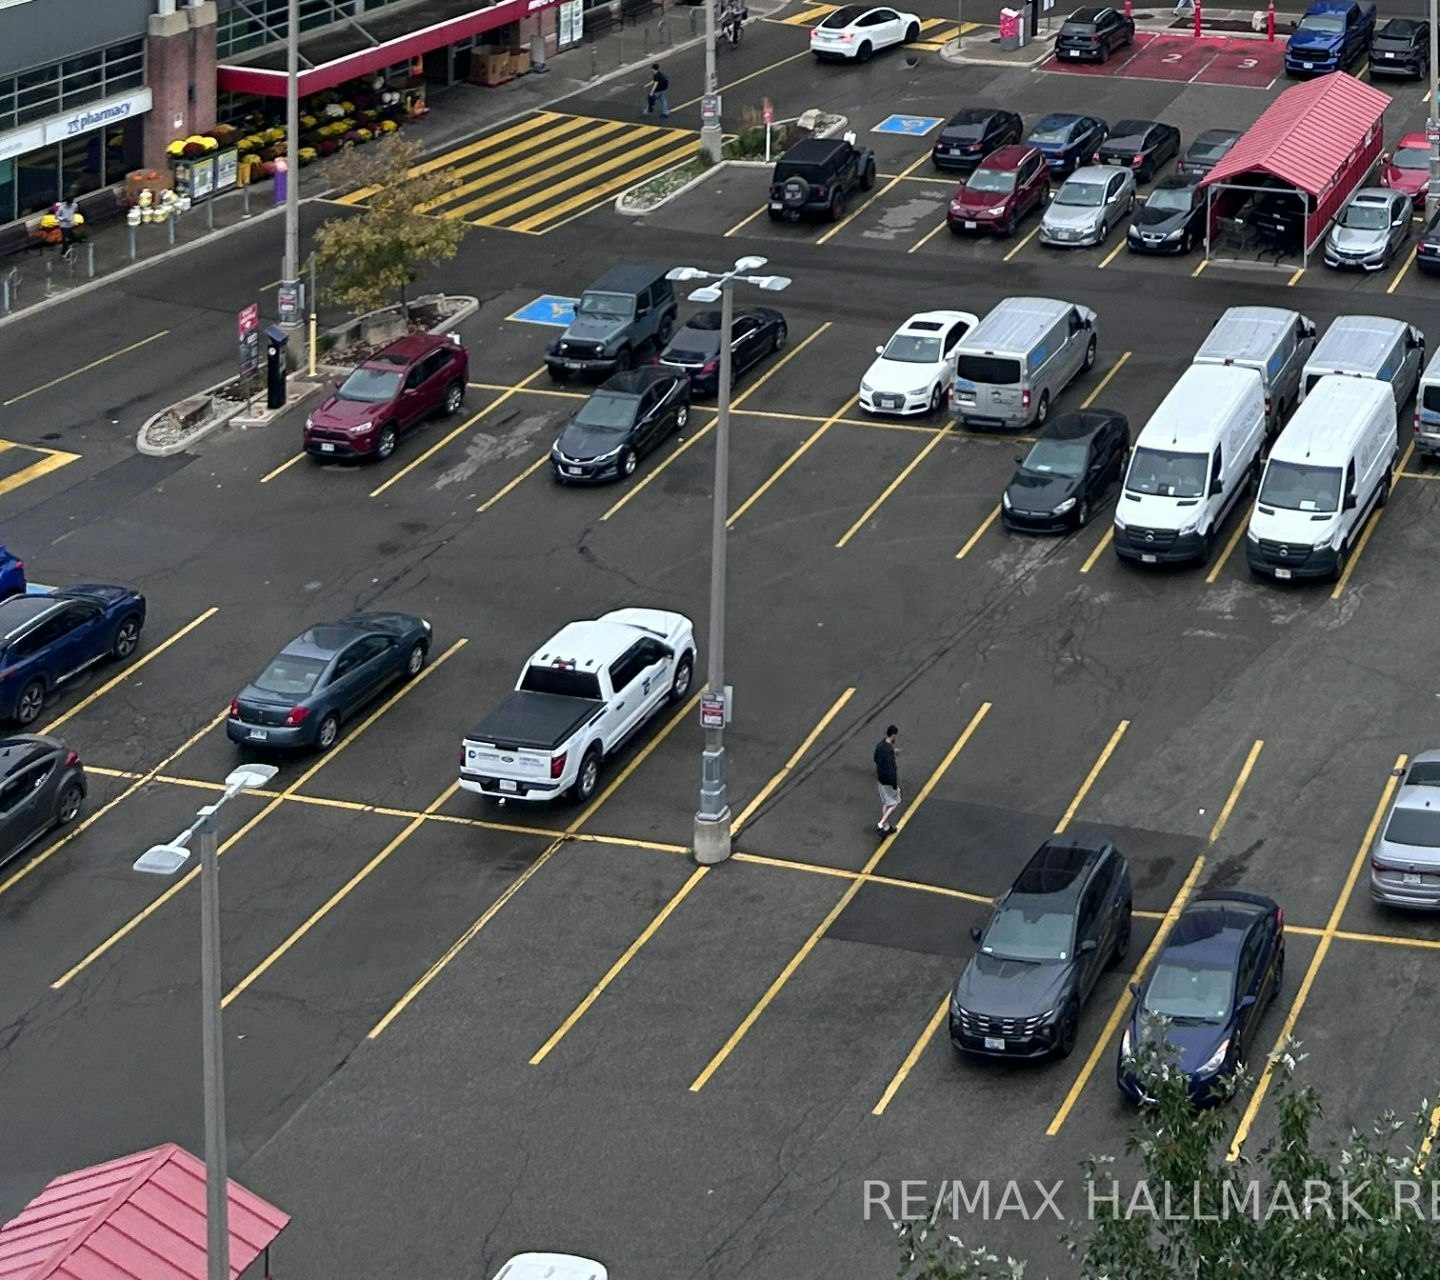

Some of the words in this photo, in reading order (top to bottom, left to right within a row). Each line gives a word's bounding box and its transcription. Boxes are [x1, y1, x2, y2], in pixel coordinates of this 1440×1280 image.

[1161, 53, 1182, 63] 2
[1238, 59, 1258, 68] 3
[81, 101, 132, 130] pharmacy
